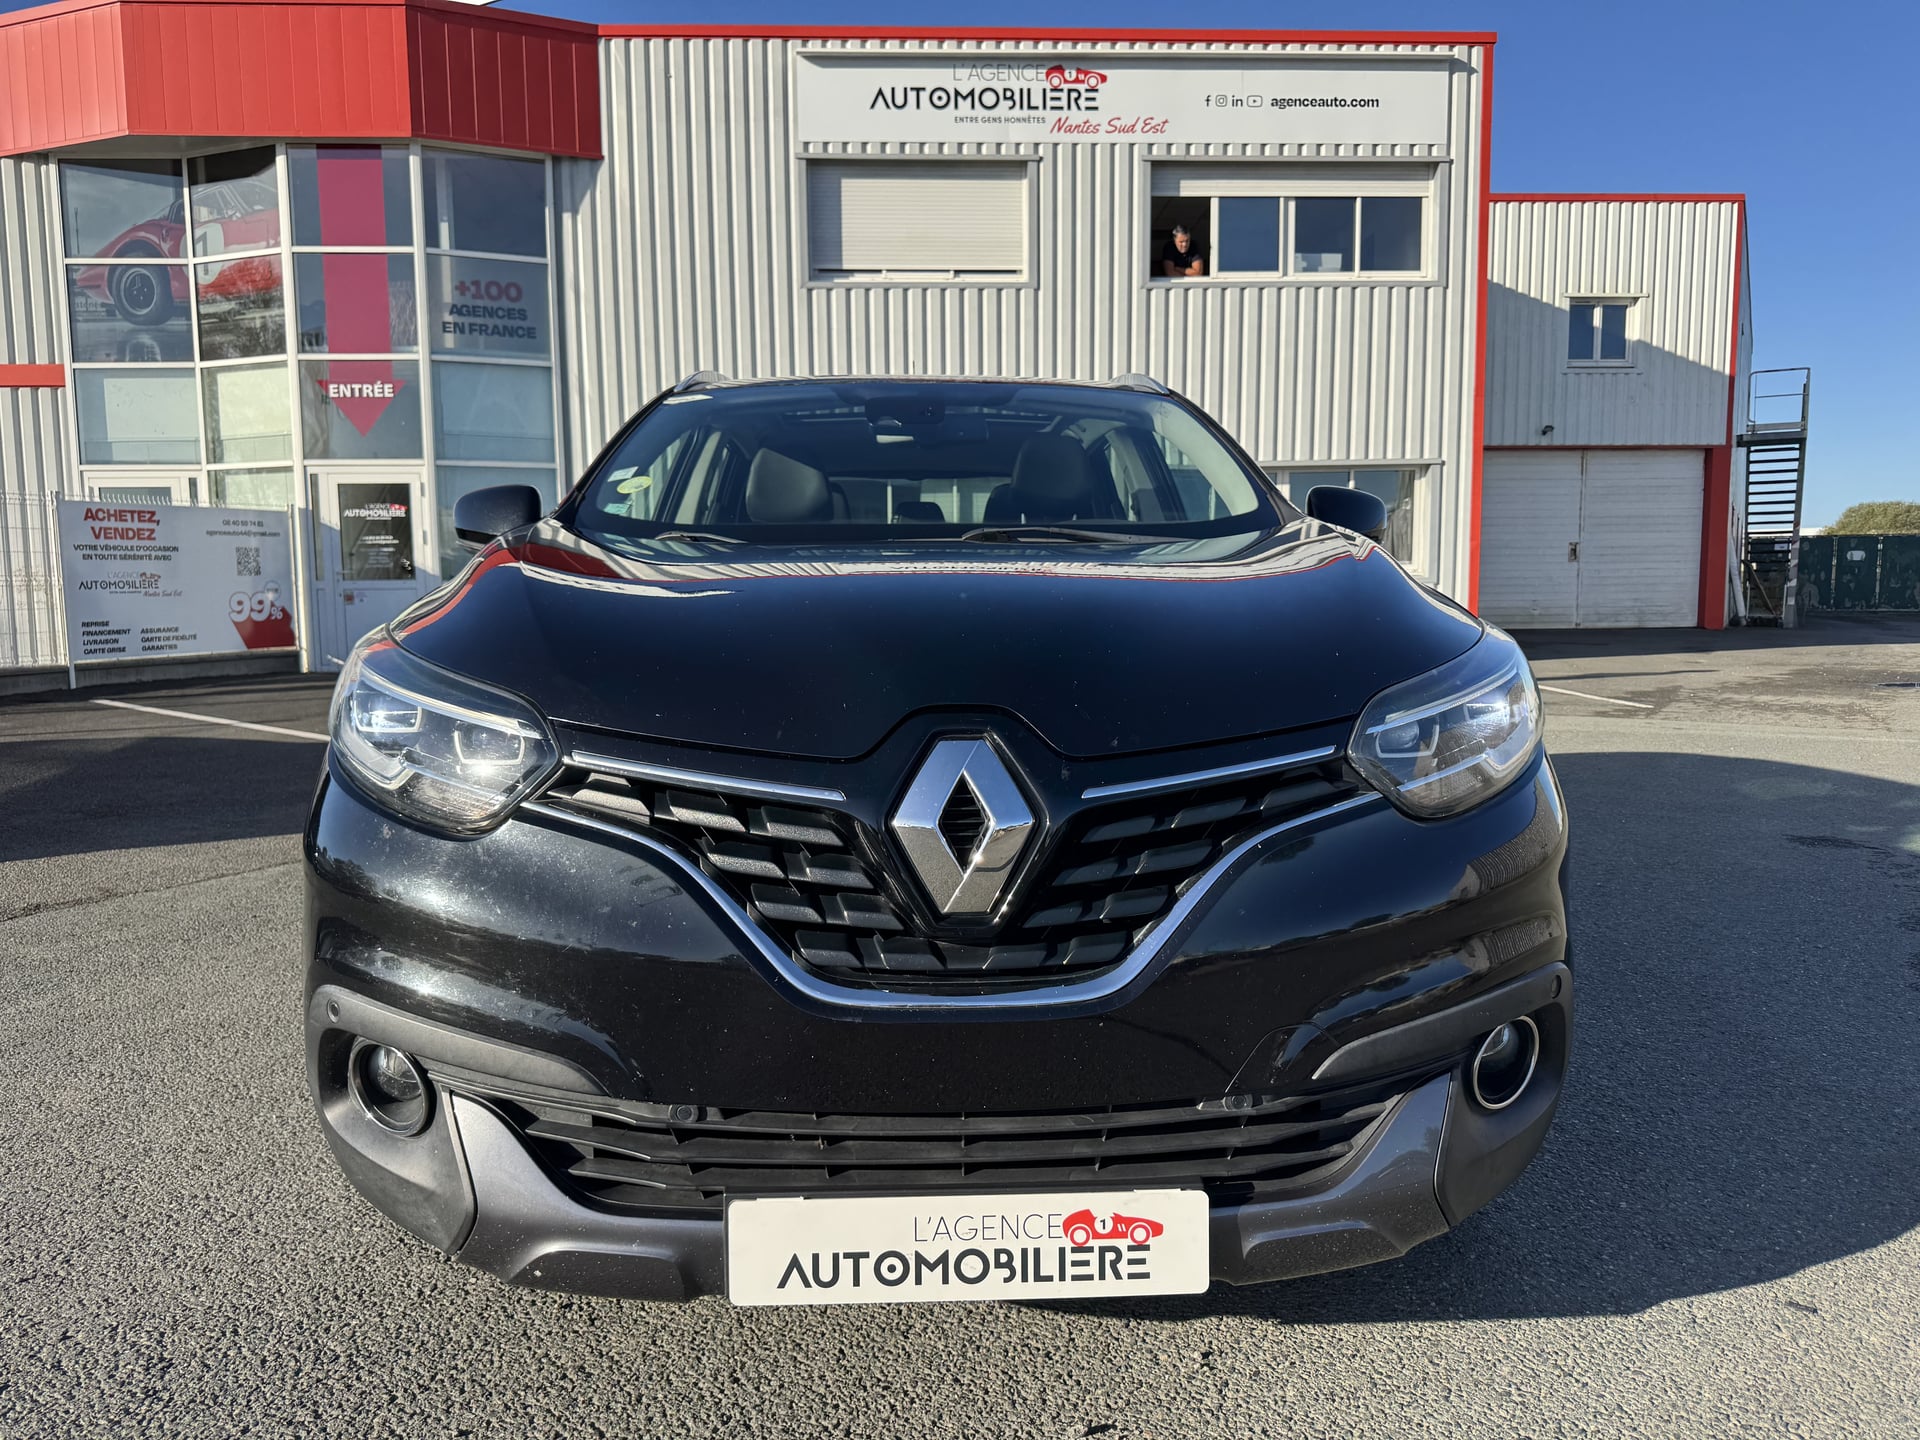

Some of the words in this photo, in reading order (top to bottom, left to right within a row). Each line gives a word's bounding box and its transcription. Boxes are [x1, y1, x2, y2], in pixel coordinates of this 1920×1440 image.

[952, 64, 1046, 82] L'AGENCE
[1270, 96, 1380, 110] agenceauto.com
[954, 116, 979, 124] ENTRE
[981, 116, 1002, 124] GENS
[1004, 114, 1046, 124] HONNÊTES
[1050, 116, 1101, 135] Nantes
[1104, 115, 1137, 134] Sud
[1140, 116, 1169, 134] Est
[454, 279, 523, 303] +100
[449, 303, 528, 321] AGENCES
[442, 321, 466, 335] EN
[468, 323, 537, 340] FRANCE
[328, 380, 394, 398] ENTRÉE
[83, 507, 160, 527] ACHETEZ,
[90, 525, 156, 541] VENDEZ
[73, 543, 99, 552] VOTRE
[99, 543, 135, 552] VÉHICULE
[136, 544, 179, 553] D'OCCASION
[82, 553, 93, 561] EN
[94, 553, 118, 561] TOUTE
[81, 621, 110, 629] REPRISE
[82, 628, 132, 637] FINANCEMENT
[140, 626, 180, 635] ASSURANCE
[82, 638, 120, 647] LIVRAISON
[141, 643, 178, 652] GARANTIES
[914, 1212, 1063, 1243] L'AGENCE
